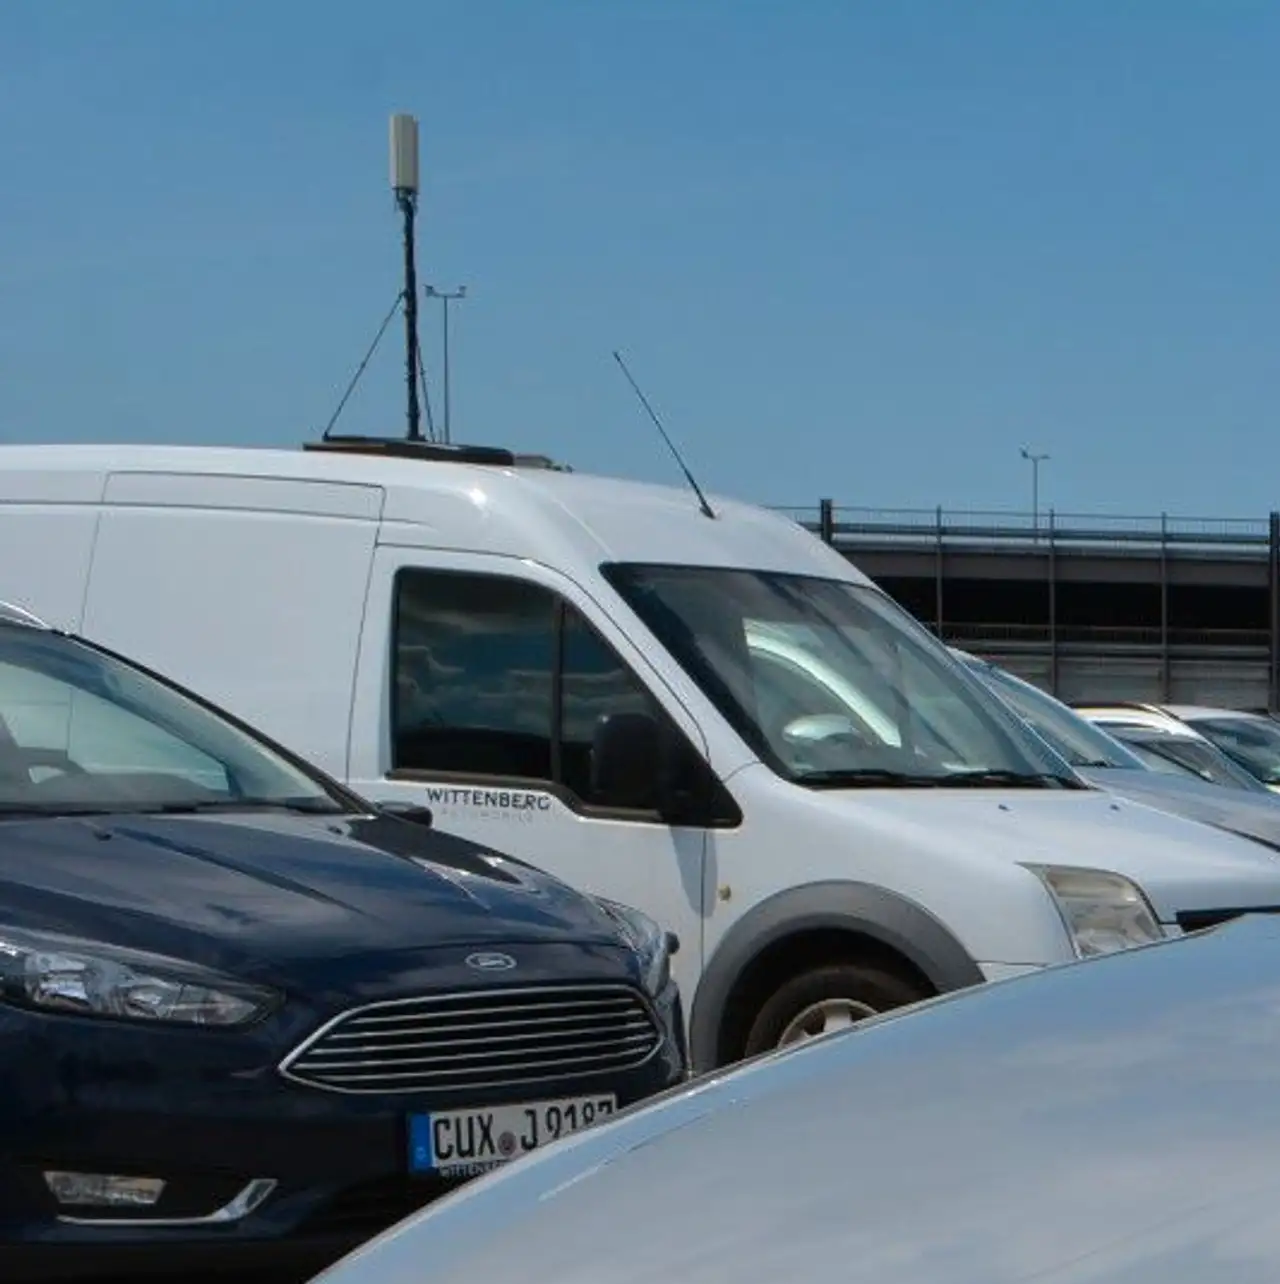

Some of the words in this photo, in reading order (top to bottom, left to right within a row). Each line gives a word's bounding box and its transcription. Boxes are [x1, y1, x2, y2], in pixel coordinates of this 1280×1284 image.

[425, 787, 550, 811] WITTENBERG
[434, 1113, 496, 1160] CUX
[521, 1108, 538, 1151] J
